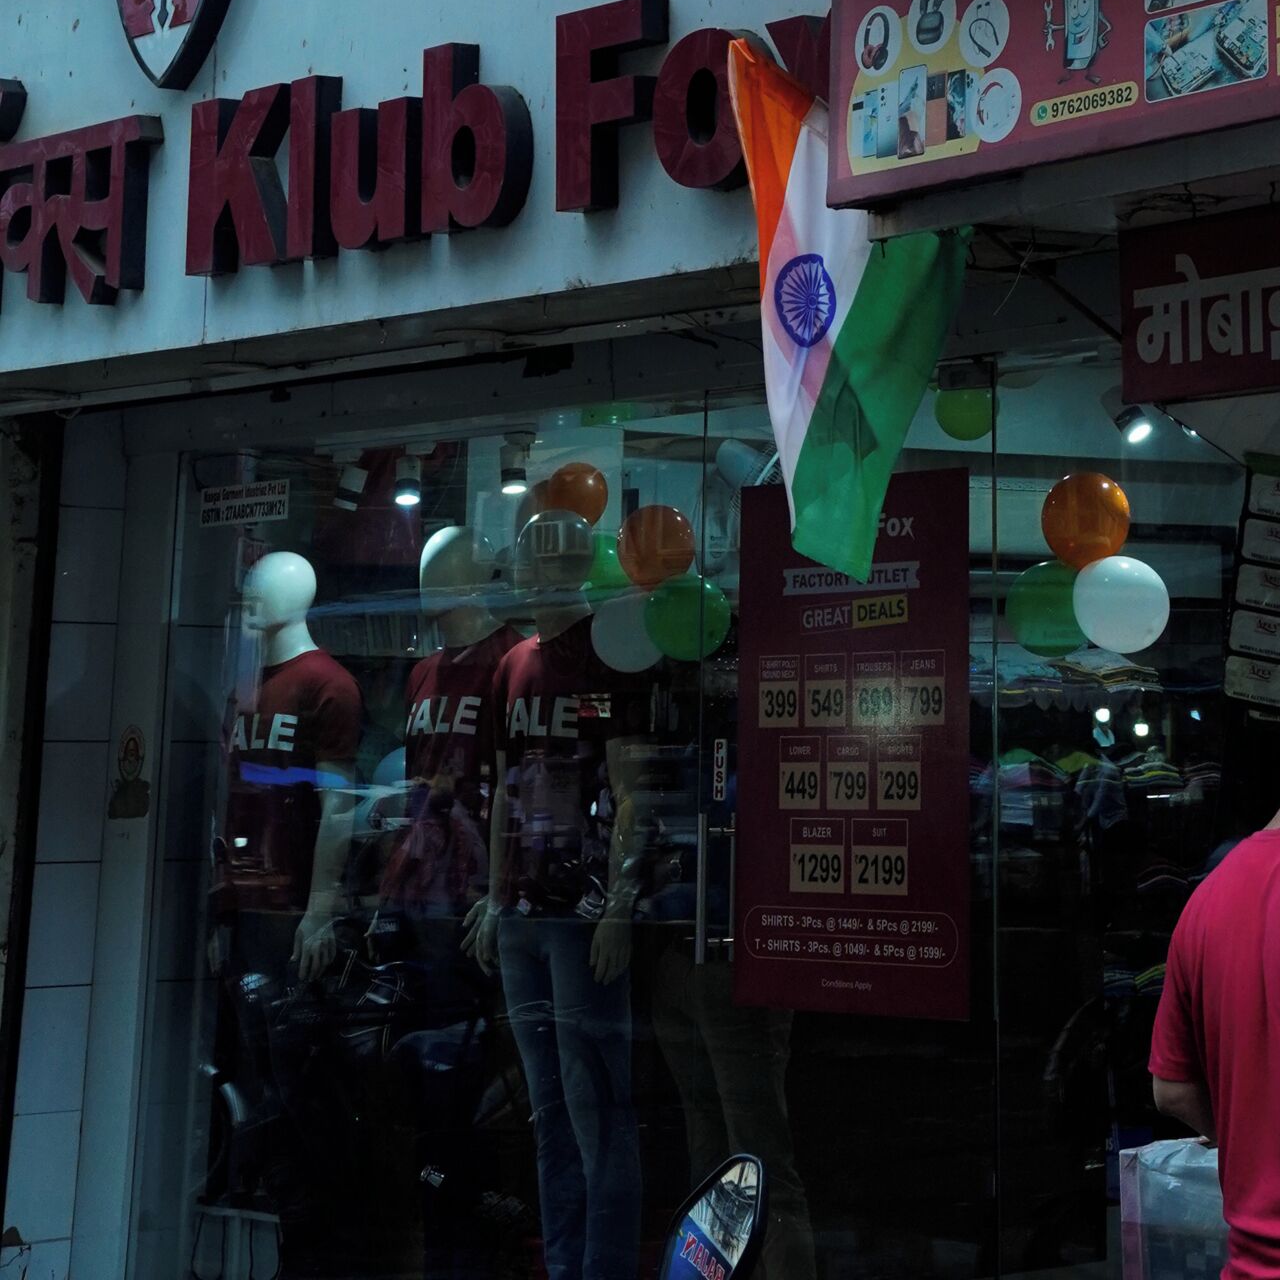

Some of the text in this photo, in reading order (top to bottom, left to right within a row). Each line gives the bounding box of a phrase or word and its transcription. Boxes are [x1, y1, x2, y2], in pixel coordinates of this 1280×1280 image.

[1050, 85, 1133, 120] 9762069382
[186, 44, 533, 276] Klub
[792, 567, 910, 590] FACTORY UTLET
[803, 599, 906, 629] GREAT DEALS
[814, 663, 839, 673] SHIRTS
[910, 658, 937, 670] JEANS
[789, 745, 812, 756] LOWER
[715, 742, 724, 798] PUSH
[802, 826, 833, 839] BLAZER
[872, 827, 887, 838] SUIT
[761, 914, 795, 928] SHIRTS
[801, 915, 824, 929] 3Pcs.
[826, 916, 836, 931] @
[867, 918, 875, 931] &
[876, 918, 898, 932] 5Pcs
[900, 919, 910, 934] @
[911, 920, 939, 933] 2199/-
[767, 939, 801, 952] SHIRTS
[808, 940, 831, 954] 3Pcs.
[832, 941, 843, 956] @
[874, 945, 881, 957] &
[883, 944, 905, 958] 5Pcs
[906, 945, 917, 961] @
[918, 946, 946, 960] 1599/-
